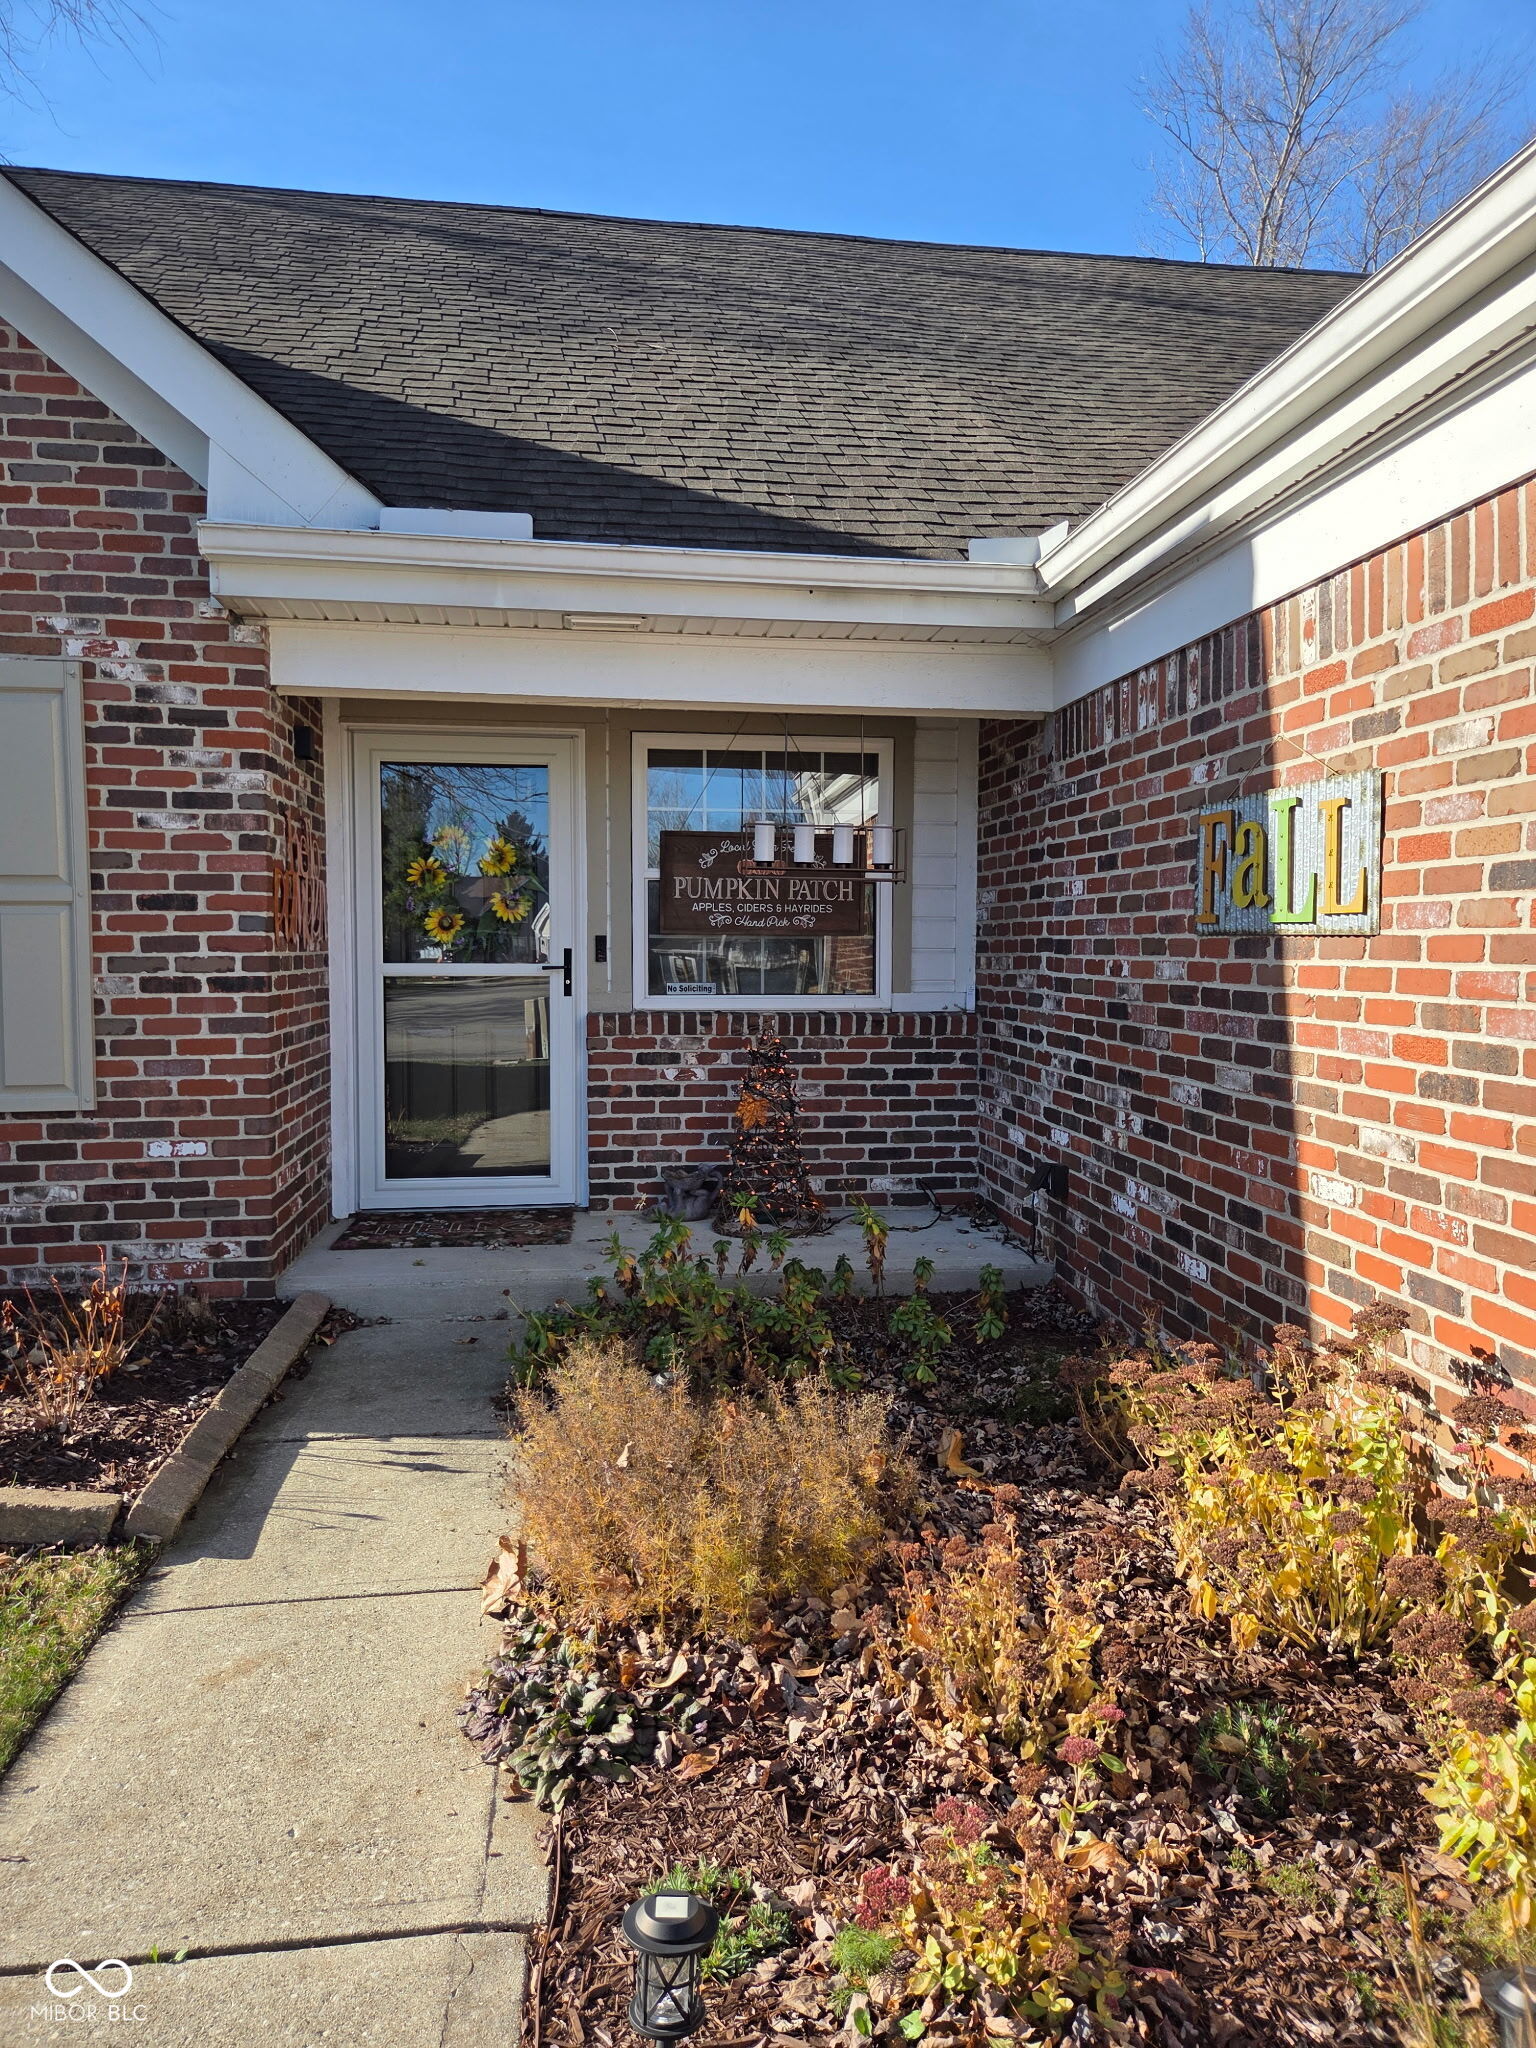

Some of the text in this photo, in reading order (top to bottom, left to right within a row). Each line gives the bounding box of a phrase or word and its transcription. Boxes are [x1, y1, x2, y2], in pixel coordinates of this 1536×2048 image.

[720, 840, 751, 853] Local
[673, 876, 854, 901] PUMPKIN PATCH
[692, 902, 833, 913] APPLES, CIDERS & HAYRIDES
[734, 915, 791, 928] Hand Pick
[679, 985, 712, 993] Soliciting
